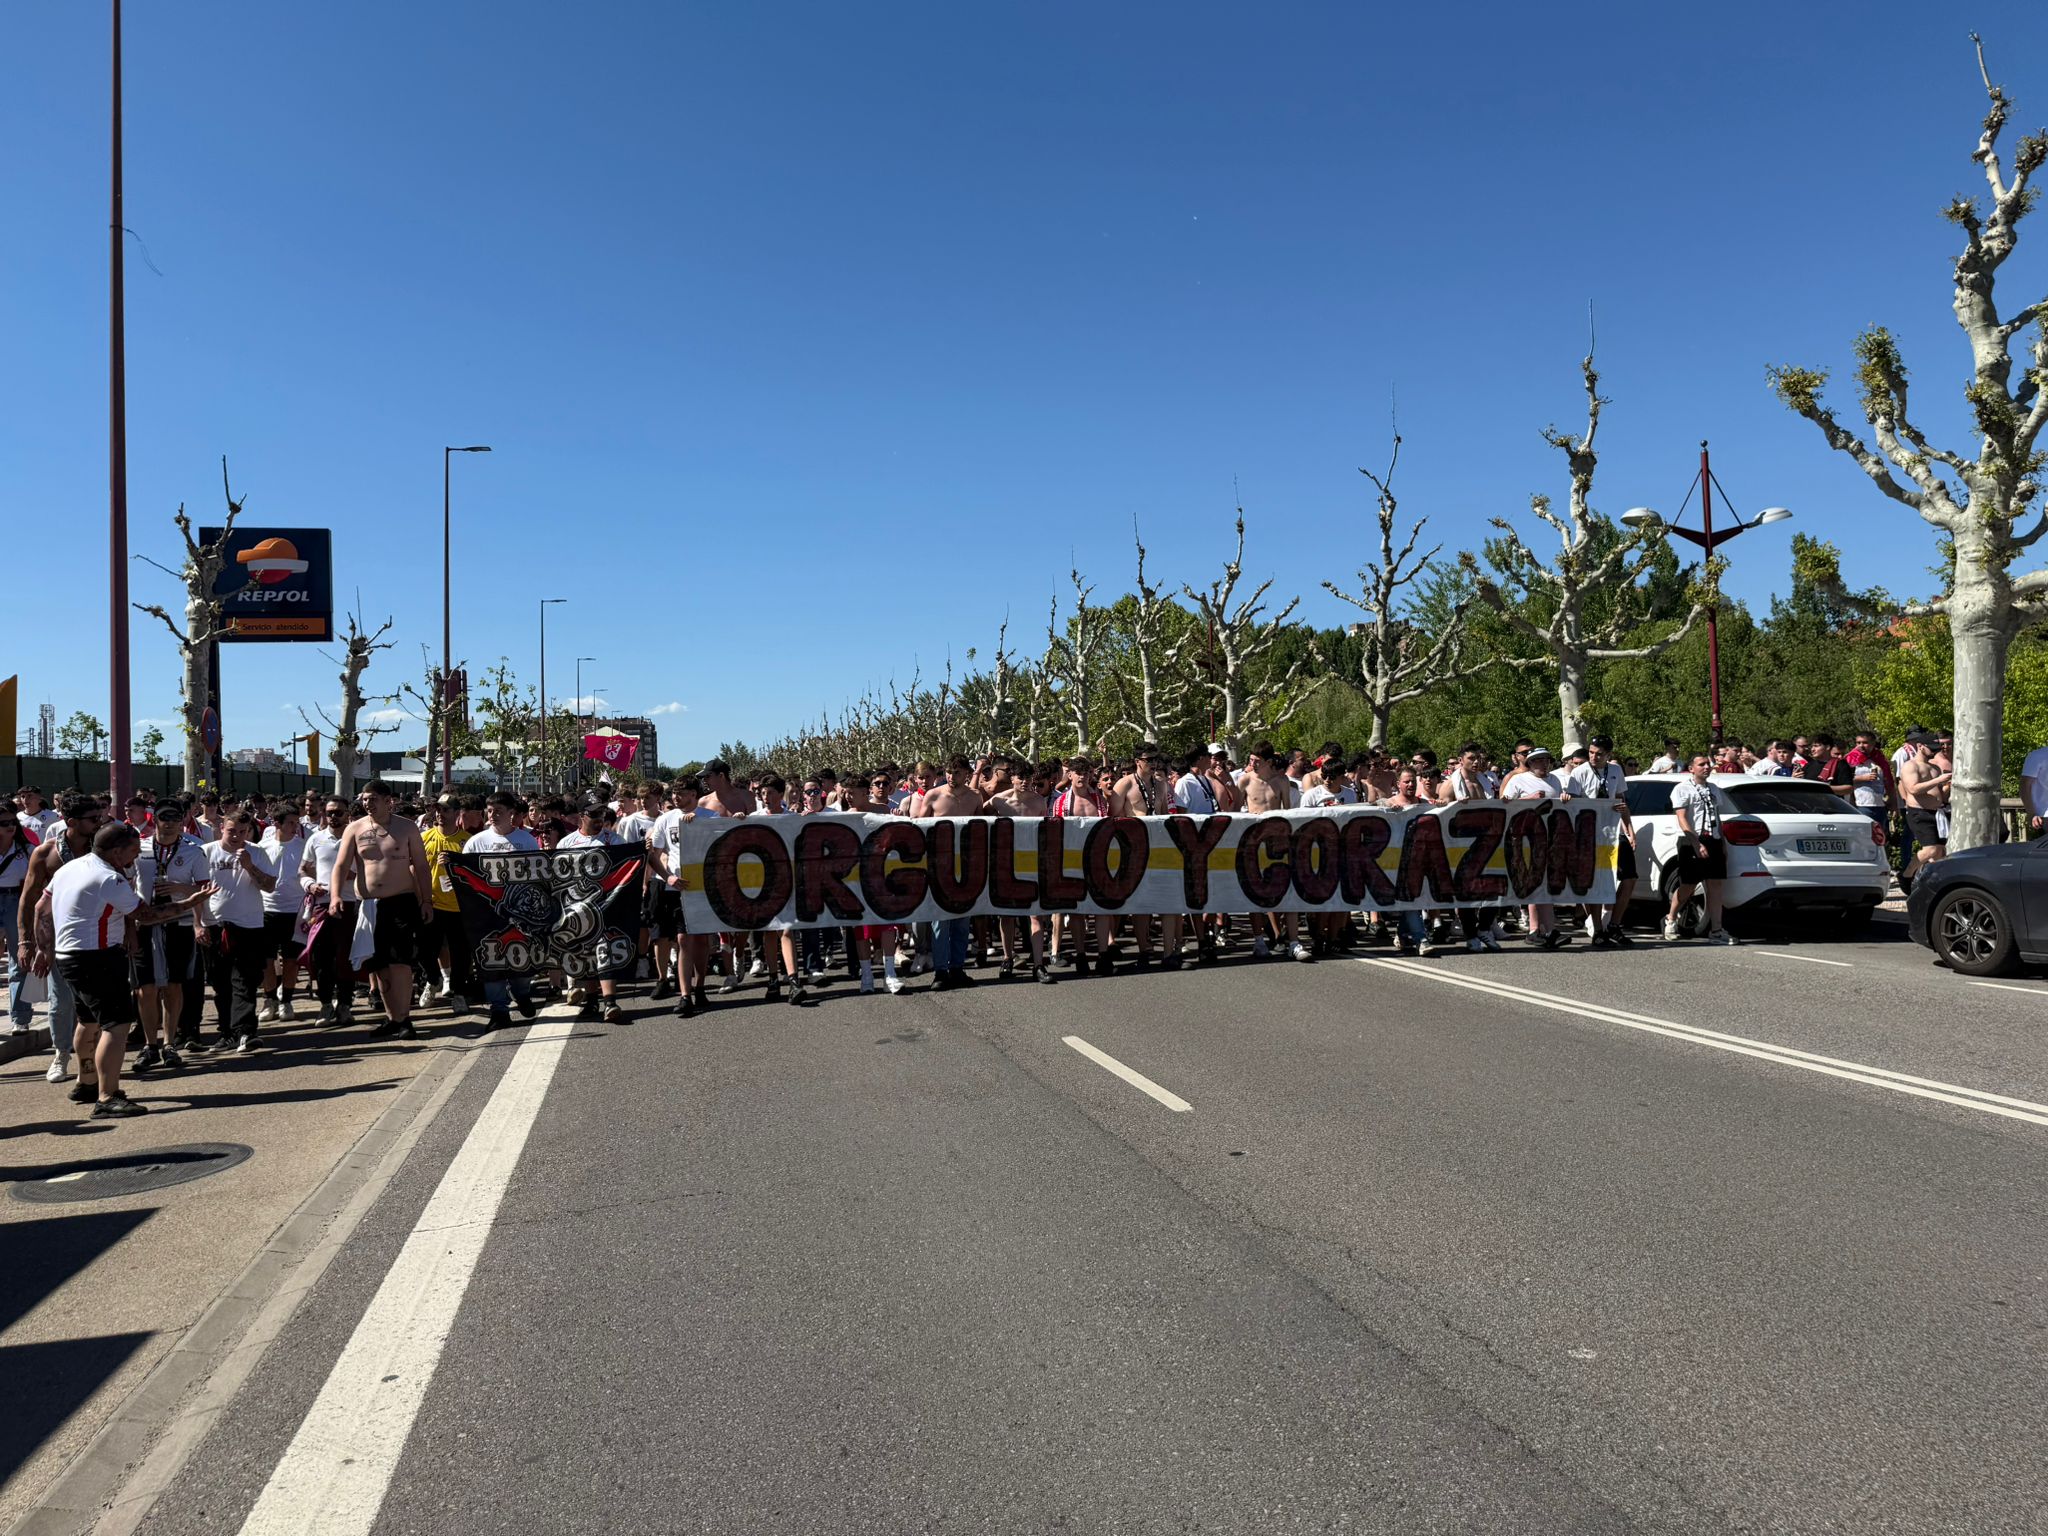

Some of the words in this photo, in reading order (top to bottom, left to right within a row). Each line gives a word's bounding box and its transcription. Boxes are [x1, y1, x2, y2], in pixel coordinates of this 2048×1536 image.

[237, 590, 310, 602] REPSOL
[242, 623, 272, 631] Servicio
[276, 623, 309, 631] atendido
[1805, 841, 1827, 851] 9123
[1831, 841, 1847, 850] KGY
[481, 850, 608, 884] TERCIO
[703, 816, 1150, 930] ORGULLO
[1164, 815, 1232, 910] Y
[1235, 800, 1597, 908] CORAZÓN
